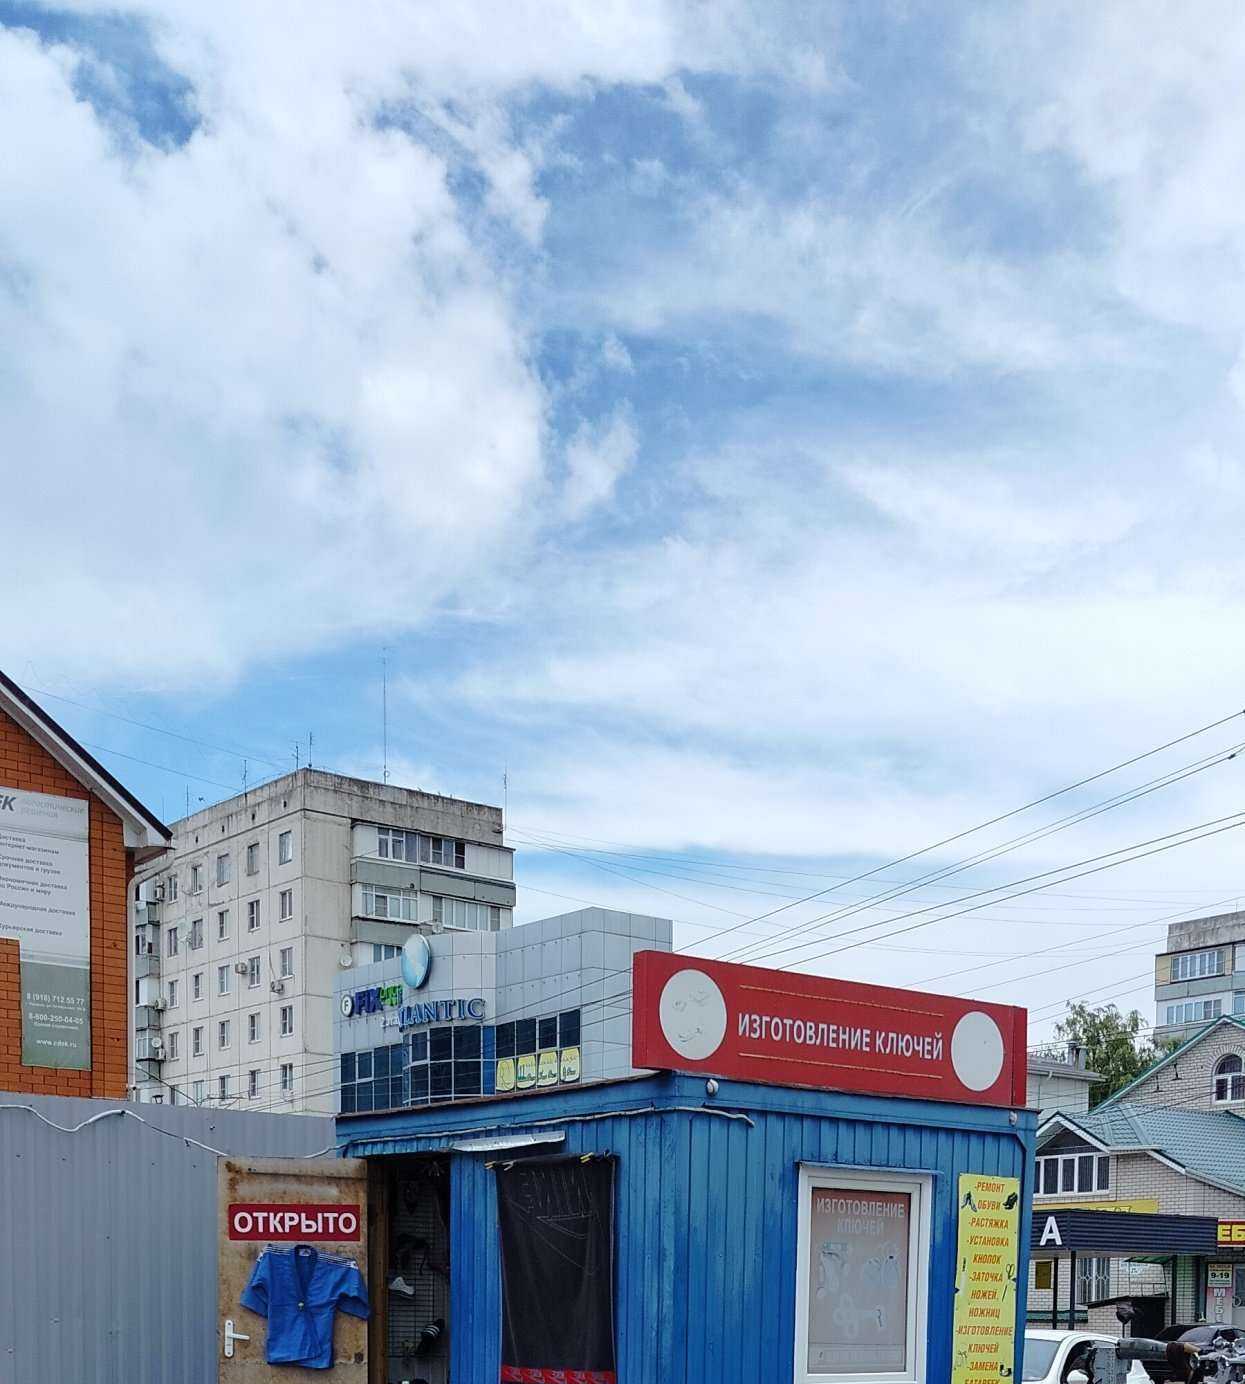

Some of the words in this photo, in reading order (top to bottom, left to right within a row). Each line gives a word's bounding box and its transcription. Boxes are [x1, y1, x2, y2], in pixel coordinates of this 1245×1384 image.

[738, 1012, 871, 1052] ИЗГОТОВЛЕНИЕ
[876, 1032, 943, 1061] КЛЮЧЕЙ
[816, 1198, 905, 1218] ИЗГОТОВЛЕНИЕ
[234, 1212, 357, 1233] ОТКРЫТО
[837, 1217, 884, 1236] КЛЮЧЕЙ
[972, 1253, 1002, 1265] КНОПОК
[968, 1307, 1000, 1319] НОЖНИЦ
